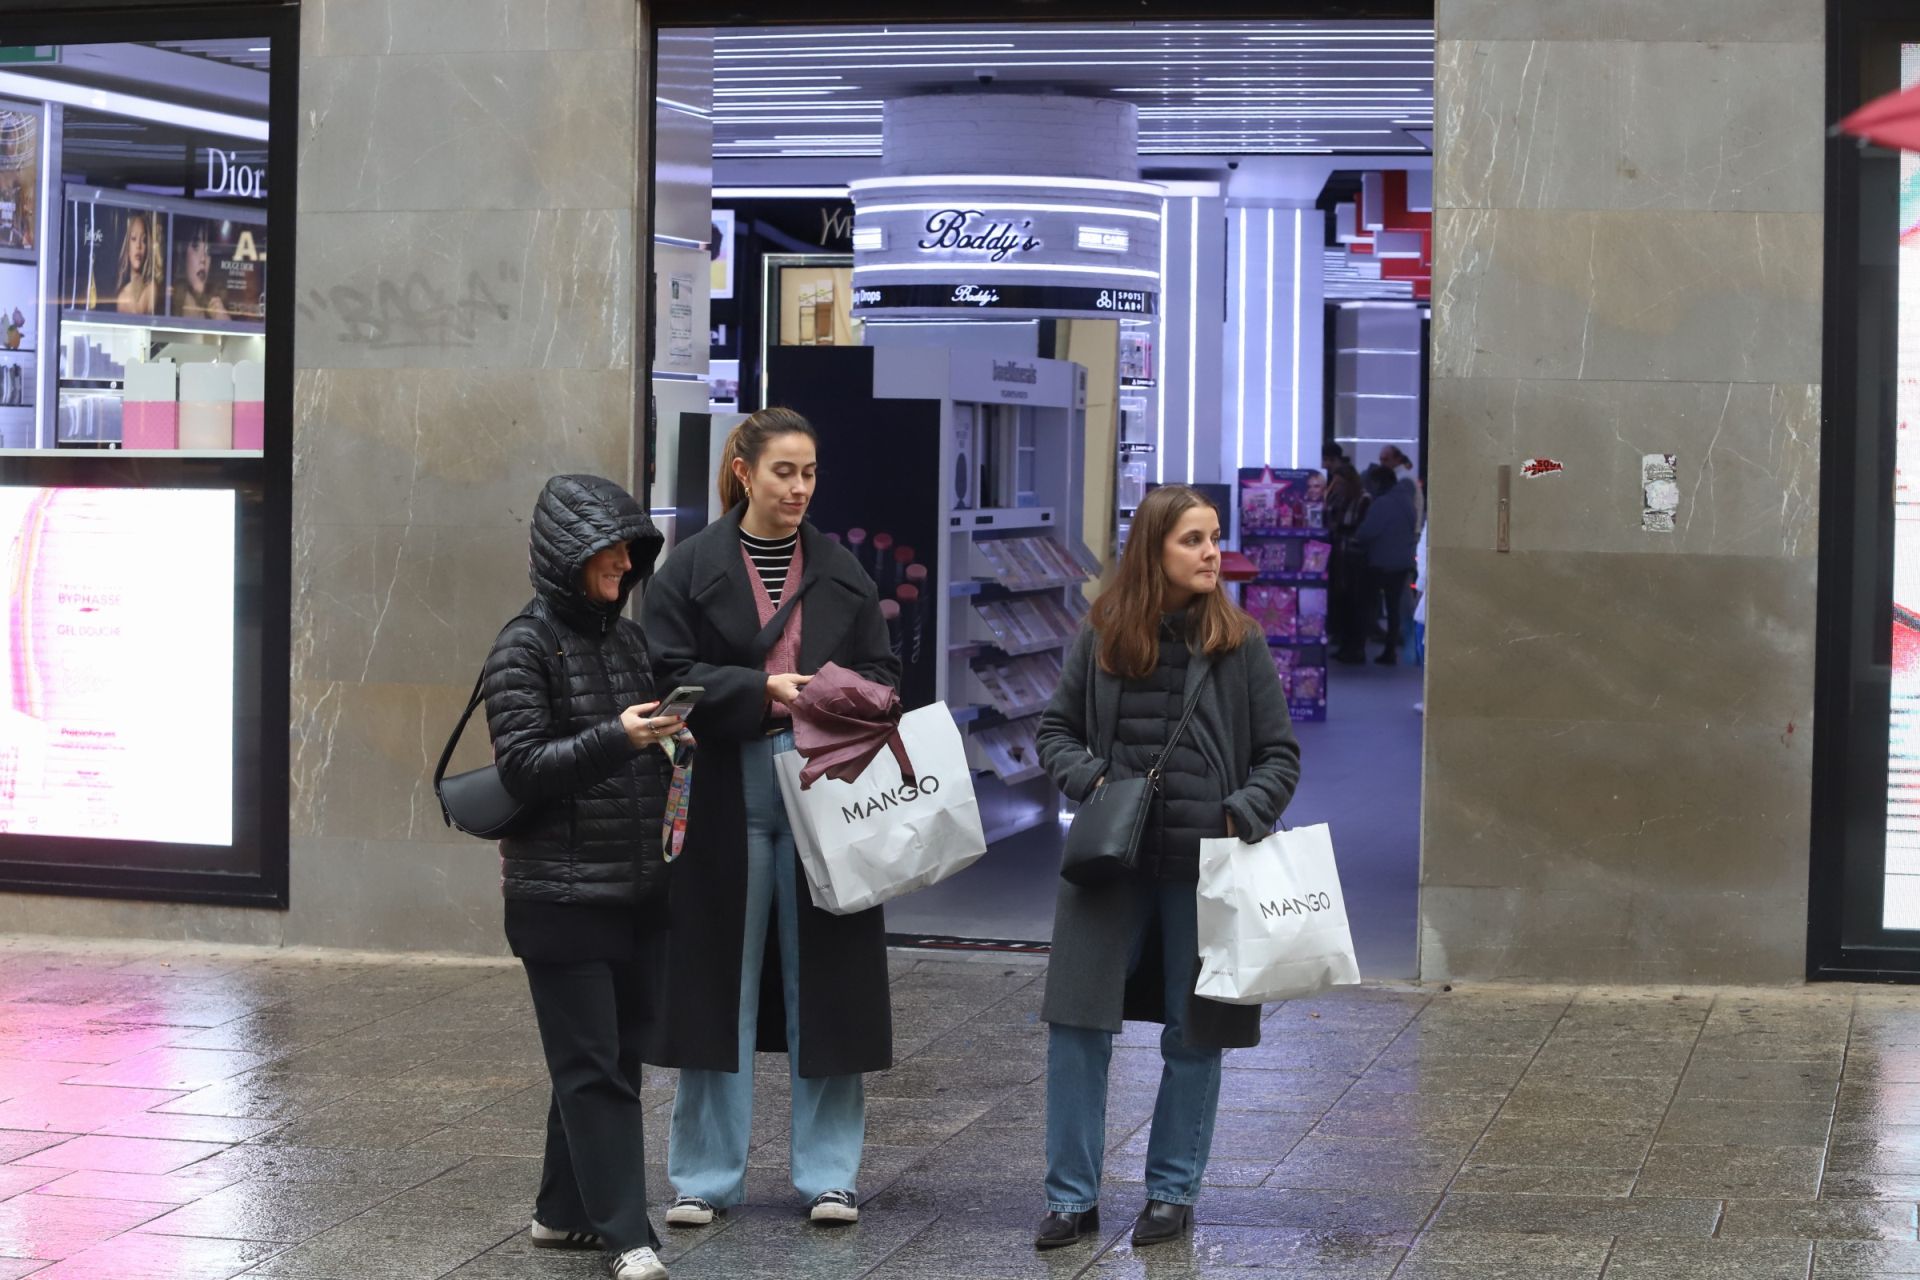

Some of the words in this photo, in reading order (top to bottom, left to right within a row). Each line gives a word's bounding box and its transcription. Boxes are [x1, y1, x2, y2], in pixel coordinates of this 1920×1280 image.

[206, 147, 266, 198] Dior
[917, 208, 1040, 262] Boddy's
[860, 289, 881, 304] Drops
[951, 284, 1000, 306] Boddy's
[1117, 291, 1142, 301] SPOTS
[58, 592, 121, 605] BYPHASSE
[841, 775, 940, 824] MANGO
[1259, 891, 1331, 919] MANGO
